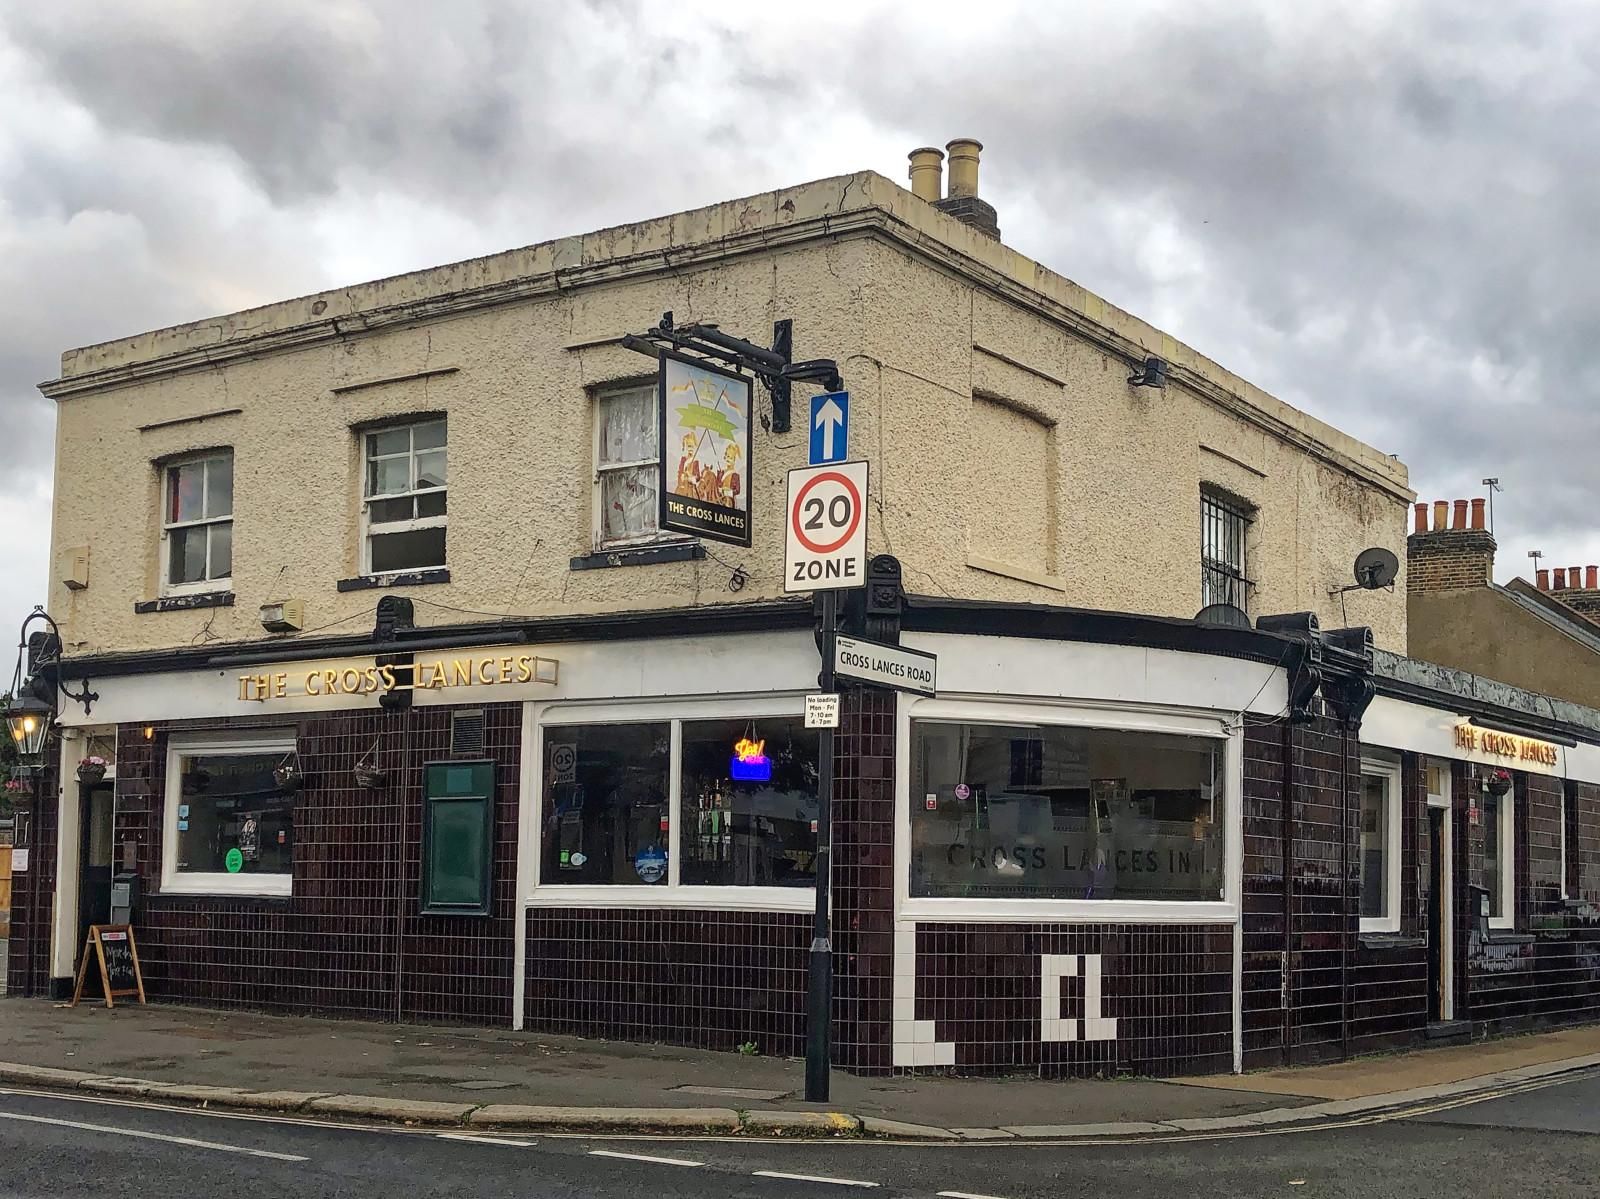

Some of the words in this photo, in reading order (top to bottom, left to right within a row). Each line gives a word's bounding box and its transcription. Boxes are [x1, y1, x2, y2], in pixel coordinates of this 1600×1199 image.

[668, 501, 684, 514] THE
[686, 506, 712, 521] CROSS
[714, 512, 744, 529] LANCES
[804, 494, 851, 530] 20
[793, 557, 856, 581] ZONE
[239, 672, 287, 700] THE
[305, 664, 396, 696] CROSS
[413, 655, 533, 690] LANCES
[840, 651, 869, 669] CROSS
[872, 658, 905, 677] LANCES
[907, 666, 931, 683] ROAD
[817, 696, 837, 704] loading
[1455, 725, 1478, 750] THE
[1481, 731, 1517, 758] CROSS
[1519, 740, 1557, 766] LANCES
[947, 843, 1046, 870] CROSS
